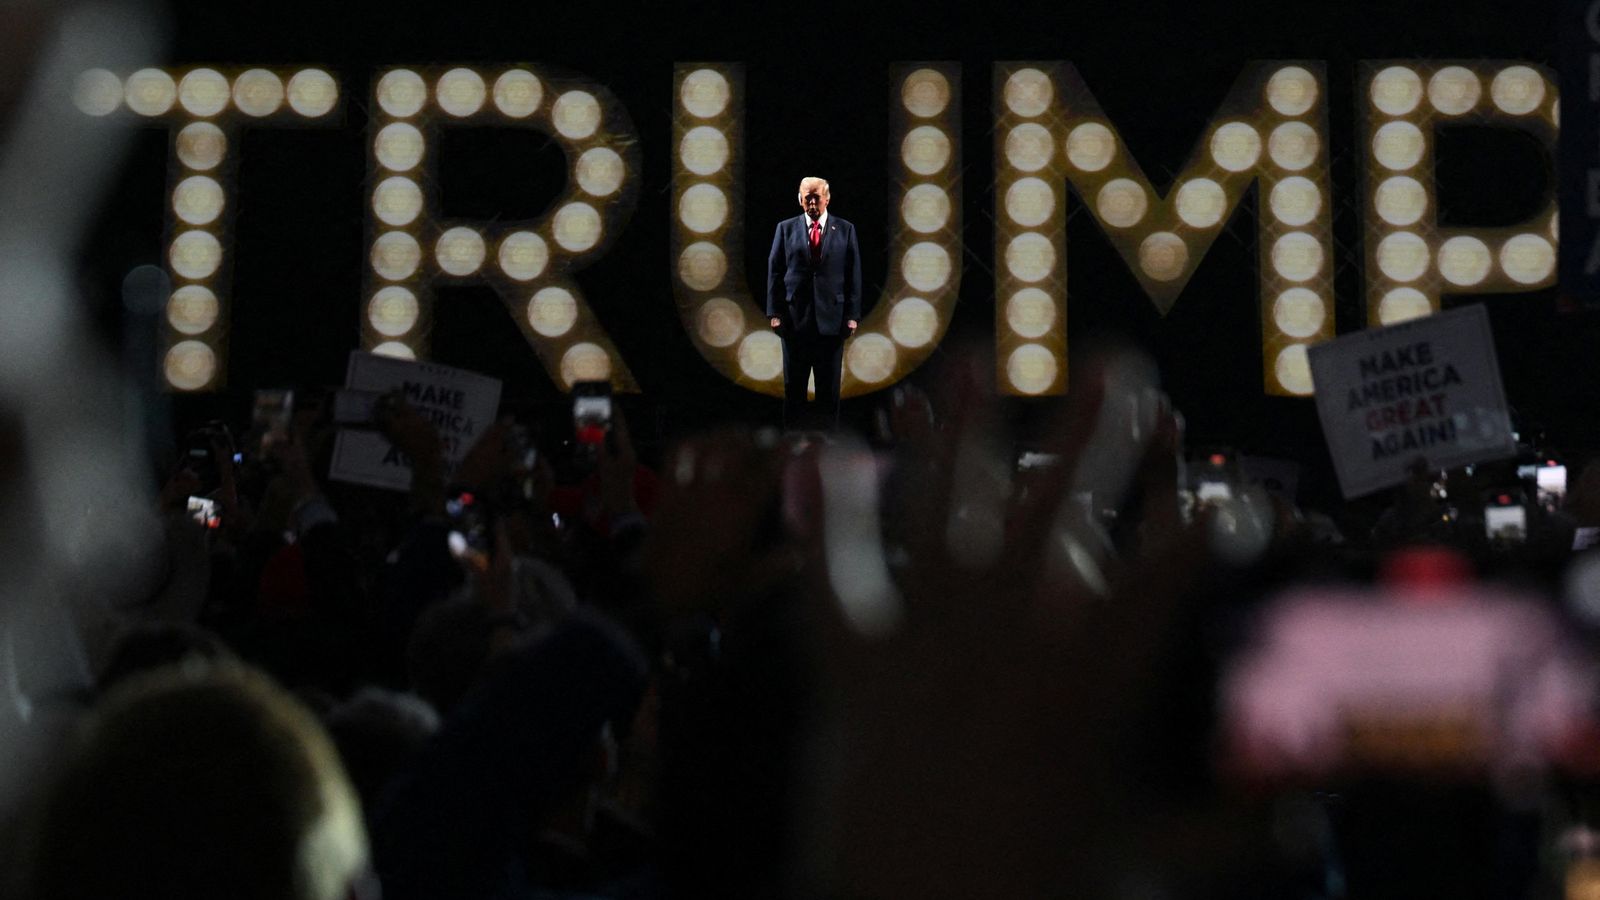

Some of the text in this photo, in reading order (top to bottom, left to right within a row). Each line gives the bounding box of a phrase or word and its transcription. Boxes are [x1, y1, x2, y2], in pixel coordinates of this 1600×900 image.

[70, 60, 1560, 397] TRUMP
[1360, 342, 1434, 380] MAKE
[401, 381, 466, 409] MAKE
[1348, 364, 1463, 409] AMERICA
[1365, 393, 1447, 432] GREAT
[1371, 417, 1457, 460] AGAIN!
